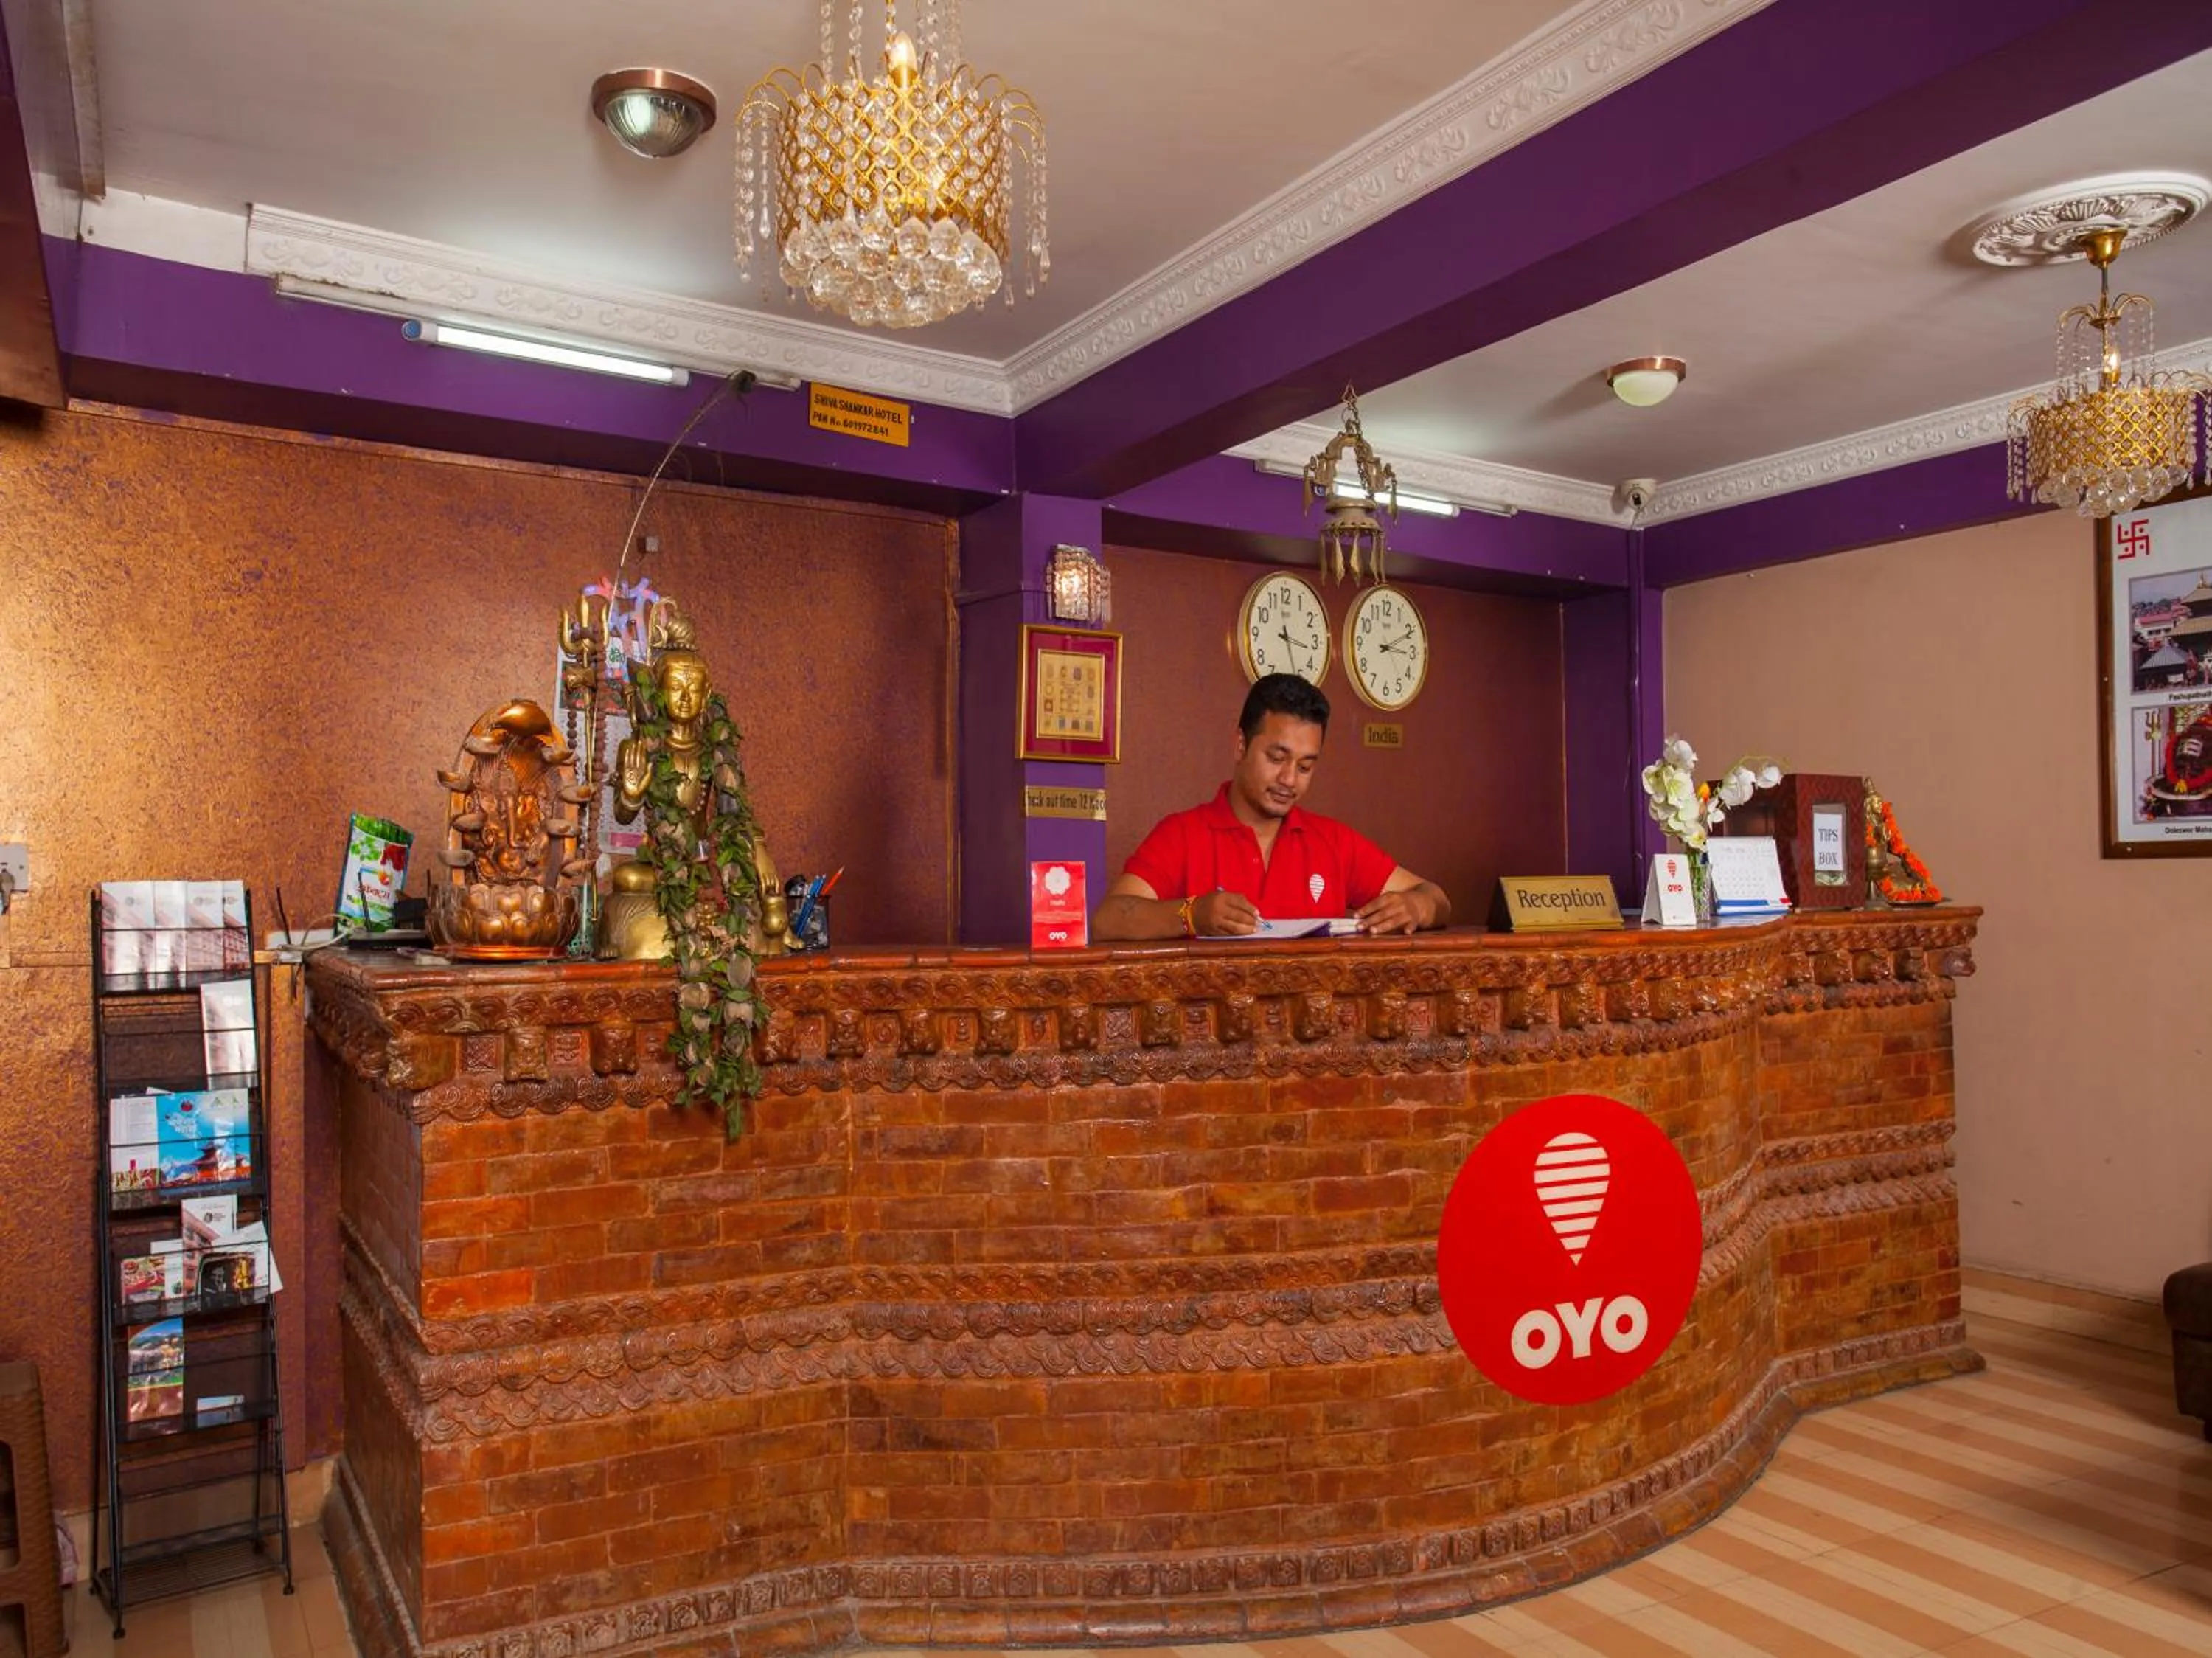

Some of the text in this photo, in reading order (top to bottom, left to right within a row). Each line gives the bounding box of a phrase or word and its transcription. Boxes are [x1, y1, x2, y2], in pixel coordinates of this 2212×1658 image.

[875, 407, 902, 424] HOTEL
[1268, 592, 1278, 610] 11
[1280, 586, 1291, 605] 12
[1297, 595, 1302, 611] 1
[1257, 606, 1269, 623] 10
[1371, 605, 1380, 620] 11
[1381, 600, 1391, 617] 12
[1397, 607, 1401, 623] 1
[1307, 611, 1314, 628] 2
[1361, 617, 1371, 634] 10
[1252, 626, 1259, 642] 9
[1405, 623, 1412, 639] 2
[1311, 634, 1319, 650] 3
[1356, 636, 1363, 651] 9
[1257, 649, 1265, 665] 8
[1409, 645, 1416, 660] 3
[1306, 655, 1314, 670] 4
[1360, 658, 1368, 673] 8
[1370, 673, 1377, 687] 7
[1405, 665, 1411, 680] 4
[1382, 681, 1389, 696] 6
[1395, 679, 1402, 693] 5
[1368, 726, 1399, 743] India
[1046, 794, 1058, 808] out
[1060, 794, 1077, 808] time
[1079, 794, 1088, 810] 12
[1818, 828, 1839, 842] TIPS
[1819, 852, 1839, 865] BOX
[1517, 888, 1606, 912] Reception
[1049, 932, 1068, 940] OYO
[1511, 1294, 1649, 1370] OYO
